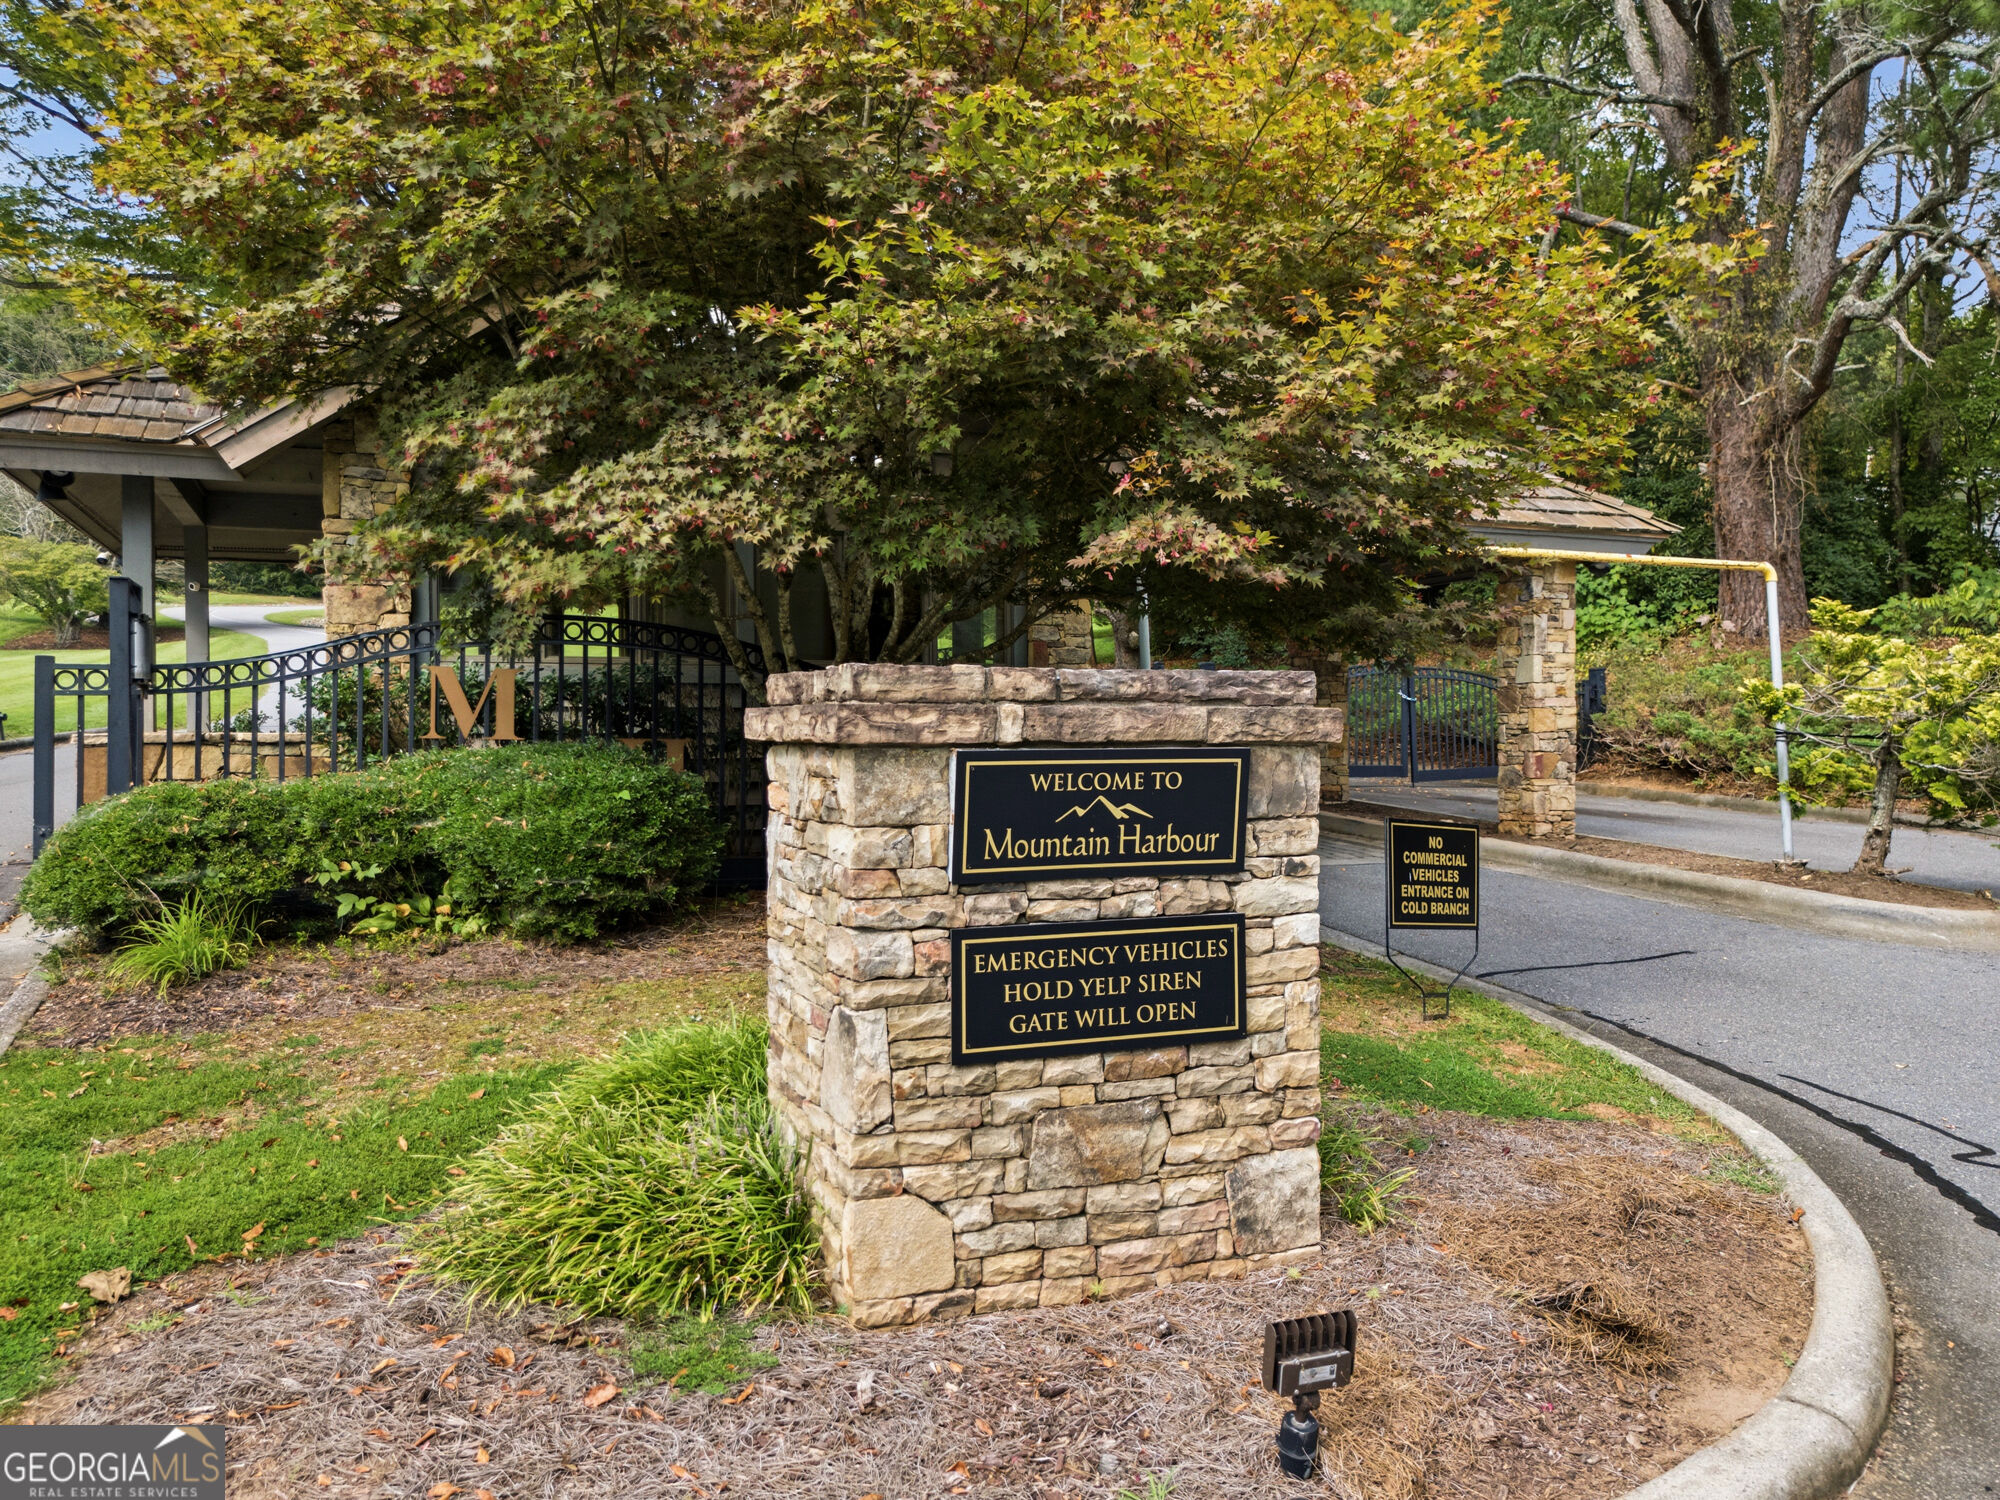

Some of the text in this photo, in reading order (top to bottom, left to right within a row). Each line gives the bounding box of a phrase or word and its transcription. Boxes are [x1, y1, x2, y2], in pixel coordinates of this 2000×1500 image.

[419, 665, 525, 741] M
[1029, 771, 1183, 792] WELCOME TO
[983, 822, 1220, 860] Mountain Harbour
[1428, 836, 1444, 850] NO
[1403, 850, 1468, 868] COMMERCIAL
[1411, 868, 1460, 883] VEHICLES
[1401, 884, 1470, 899] ENTRANCE ON
[1401, 900, 1470, 916] COLD BRANCH
[974, 938, 1228, 974] EMERGENCY VEHICLES
[1003, 970, 1201, 1003] HOLD YELP SIREN
[1009, 1000, 1196, 1034] GATE WILL OPEN
